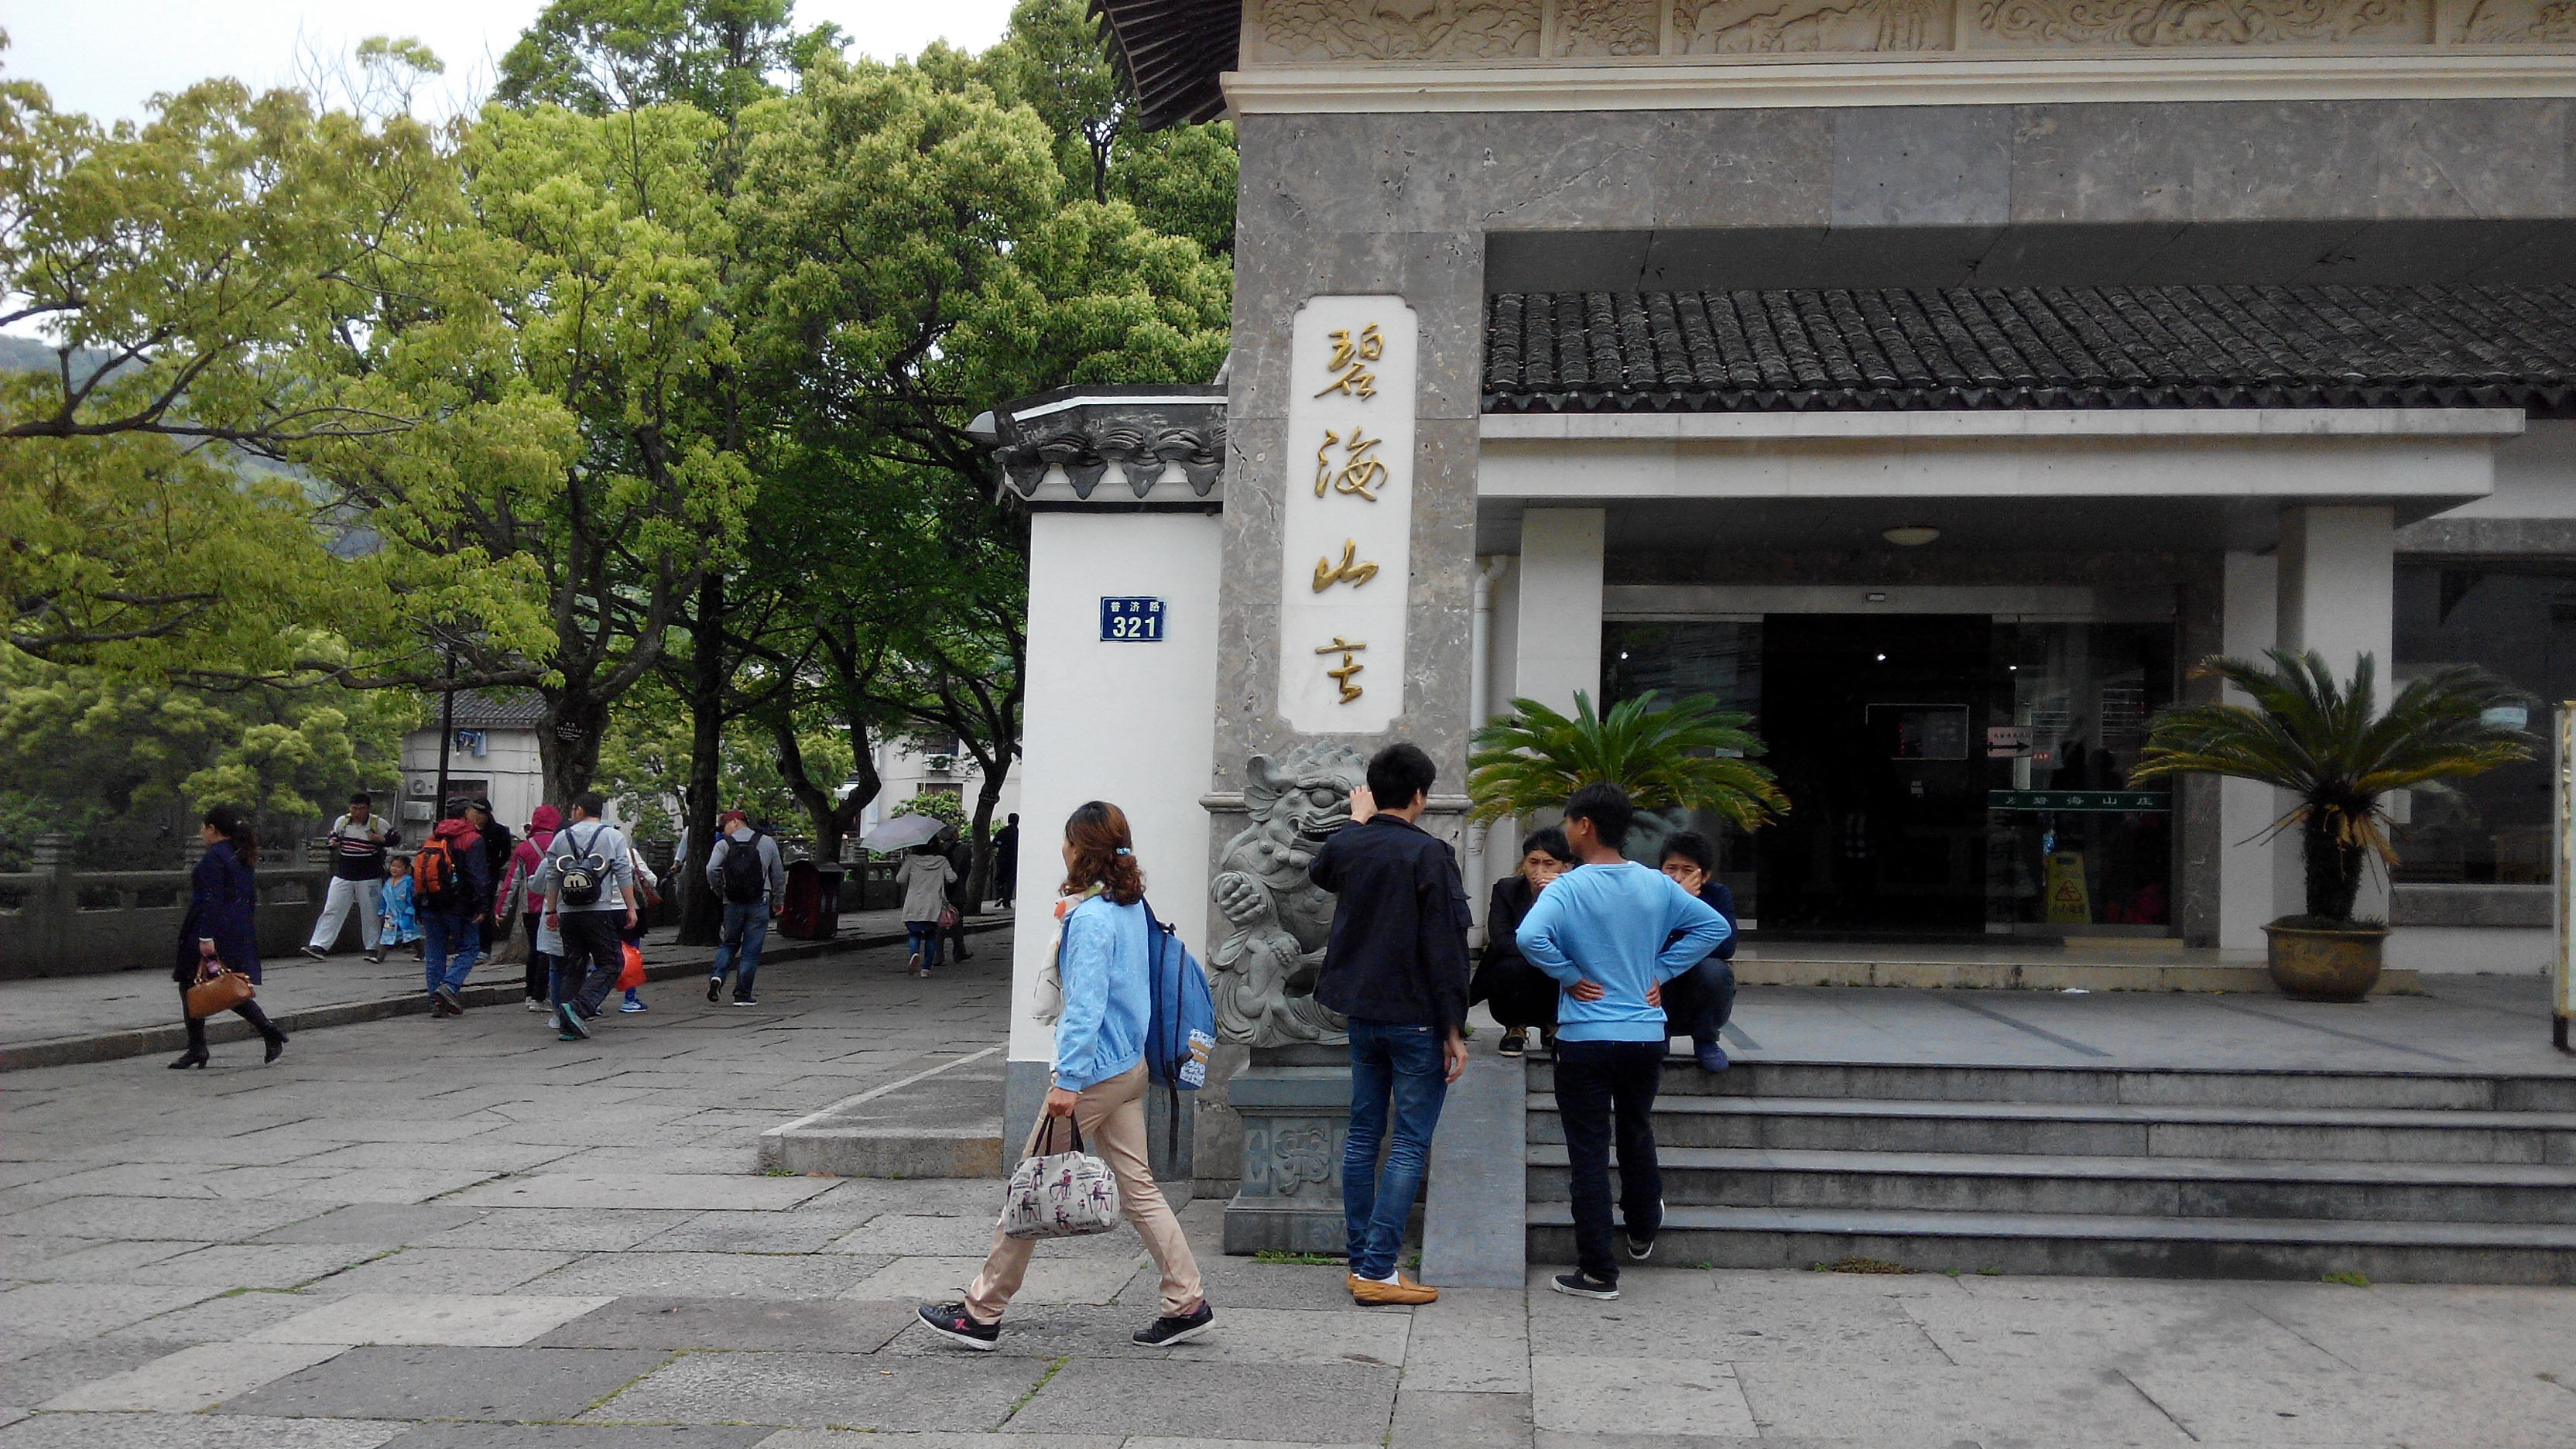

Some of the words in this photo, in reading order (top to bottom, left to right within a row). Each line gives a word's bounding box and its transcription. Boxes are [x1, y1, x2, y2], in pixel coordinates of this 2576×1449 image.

[1111, 601, 1160, 612] 普济路
[1112, 616, 1155, 638] 321
